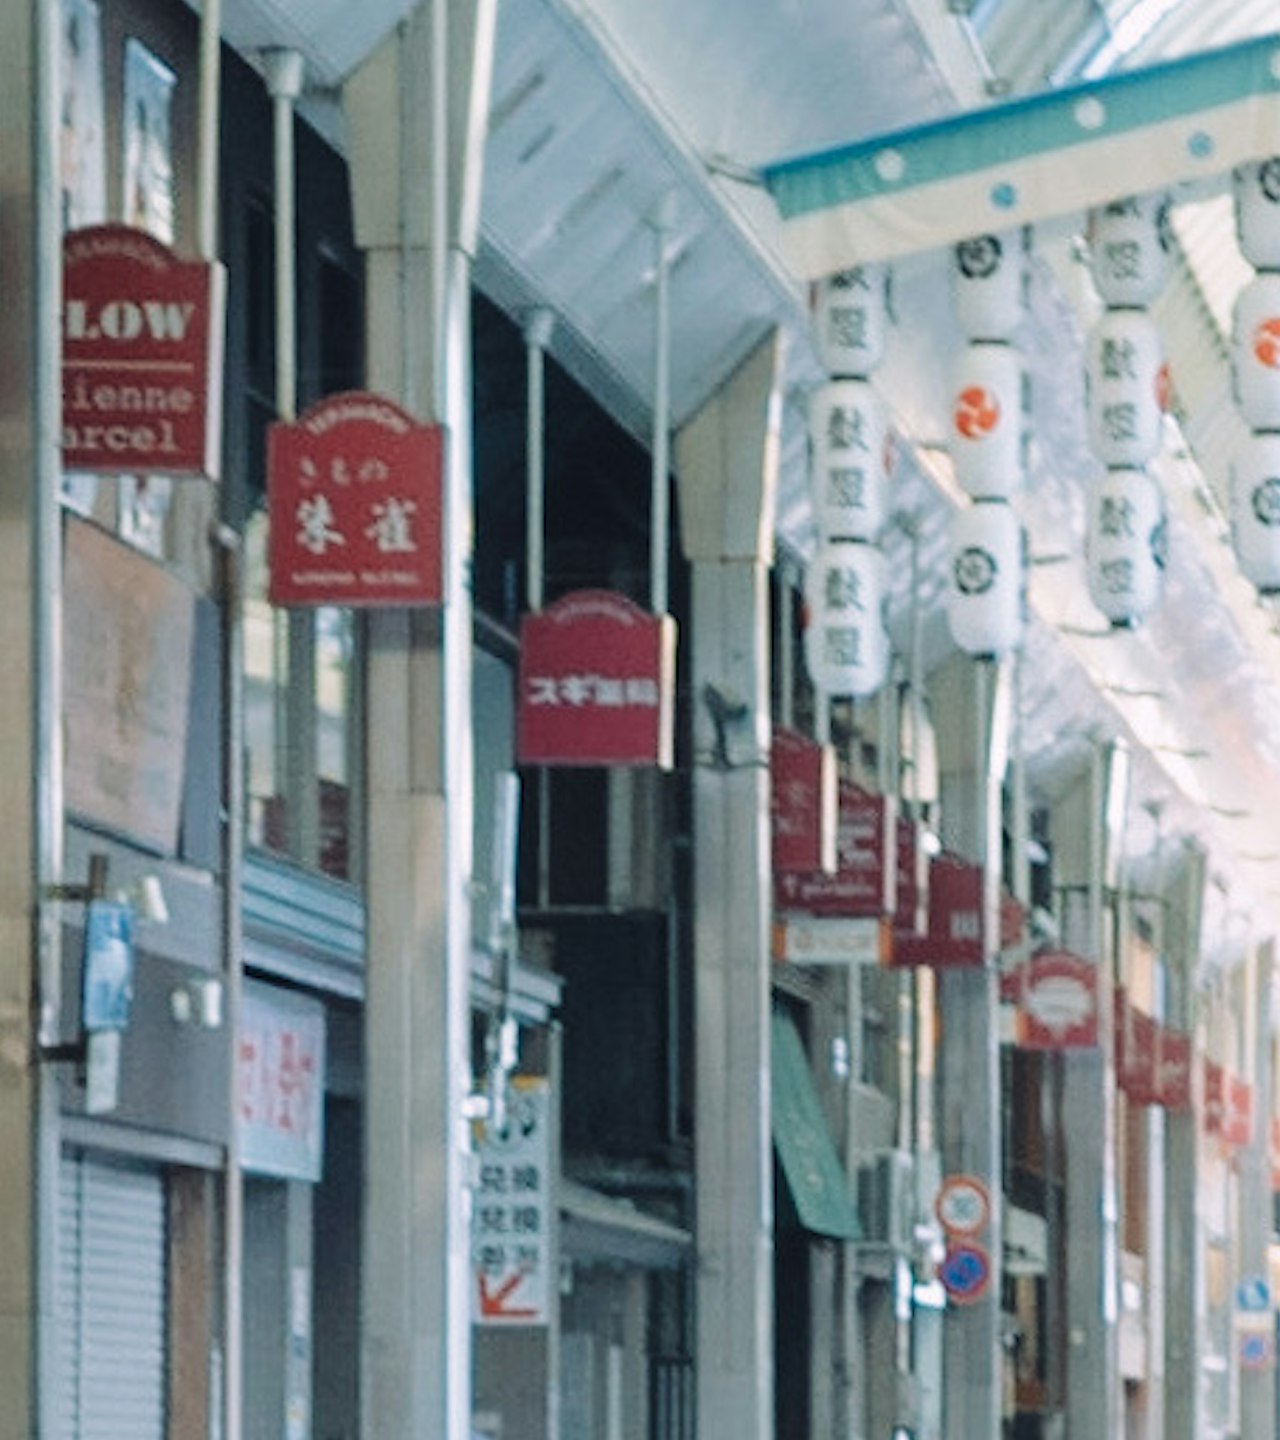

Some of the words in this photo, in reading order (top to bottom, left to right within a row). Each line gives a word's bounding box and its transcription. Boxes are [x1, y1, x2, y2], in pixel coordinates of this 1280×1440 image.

[65, 300, 197, 341] LOW
[72, 373, 195, 411] ienne
[64, 418, 178, 451] arcel
